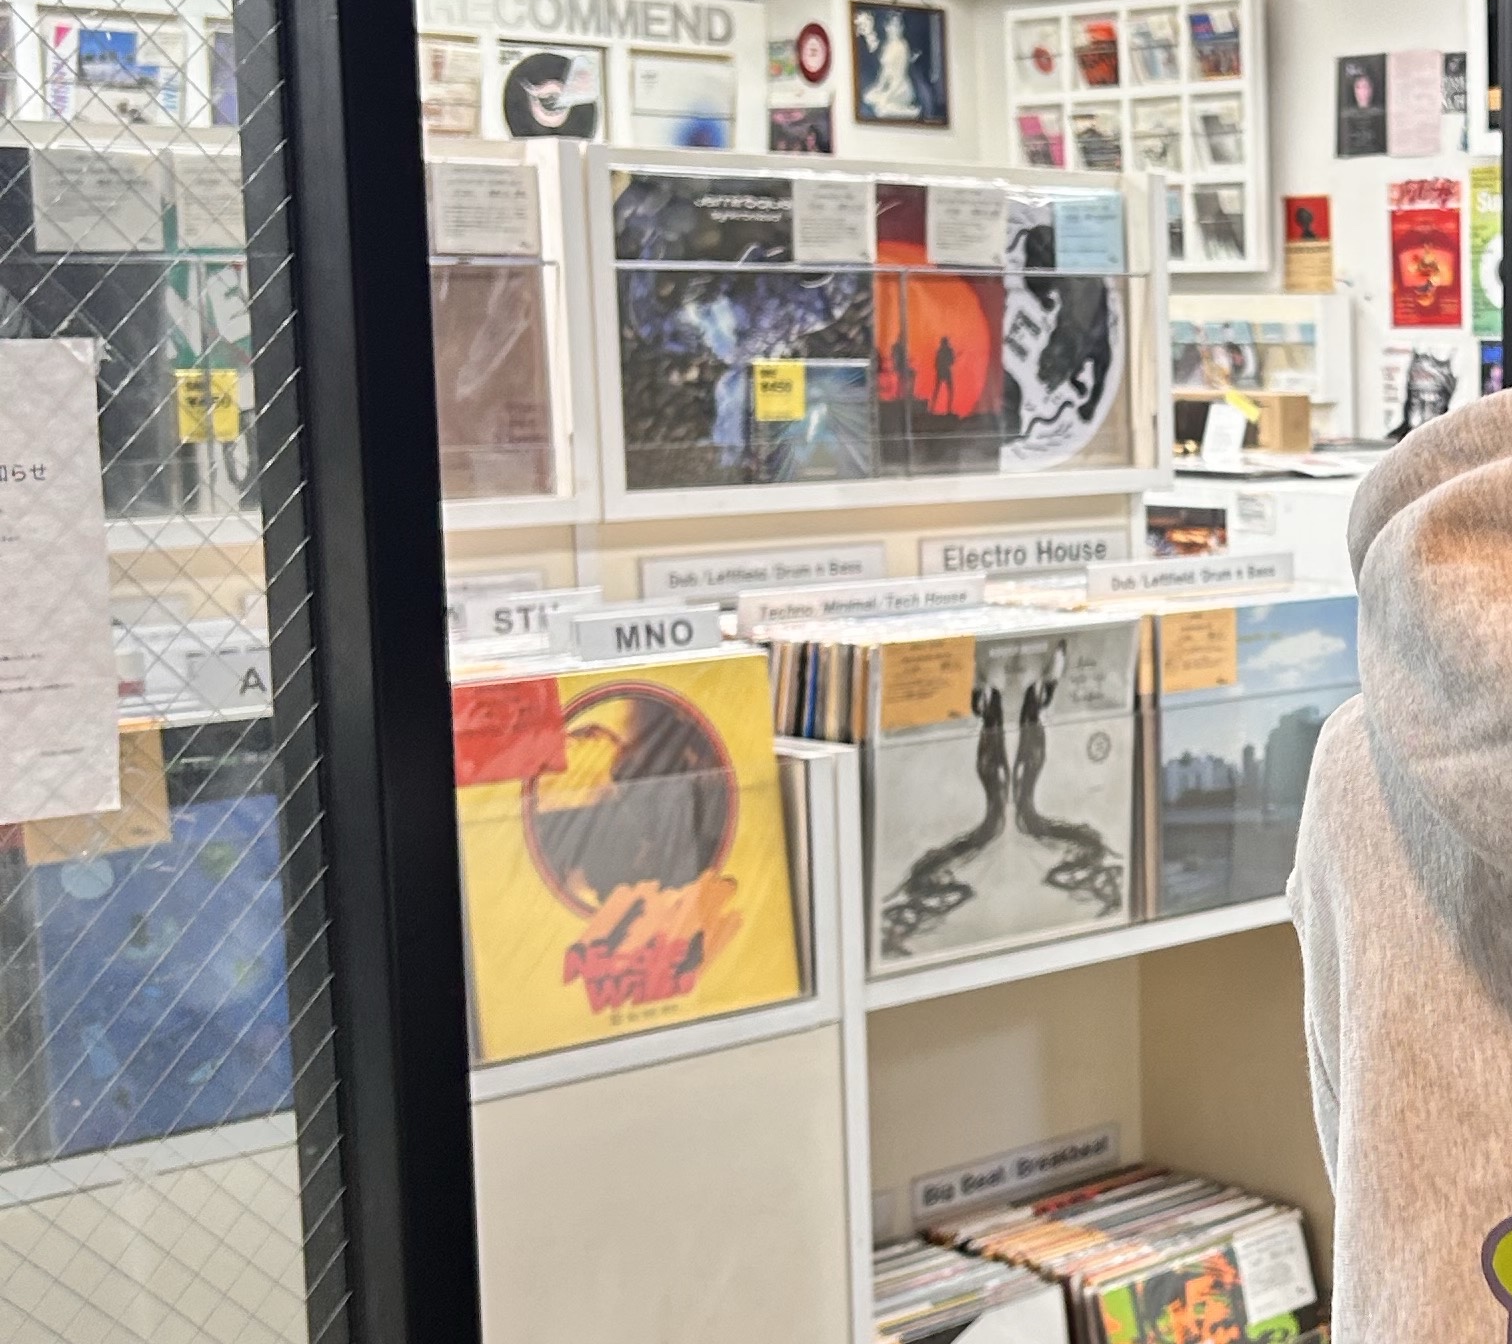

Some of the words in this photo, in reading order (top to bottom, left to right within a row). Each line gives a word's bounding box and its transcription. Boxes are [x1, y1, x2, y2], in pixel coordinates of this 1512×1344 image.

[943, 544, 1028, 572] Electro
[1036, 539, 1108, 564] House
[614, 619, 694, 653] MNO
[239, 666, 268, 695] A
